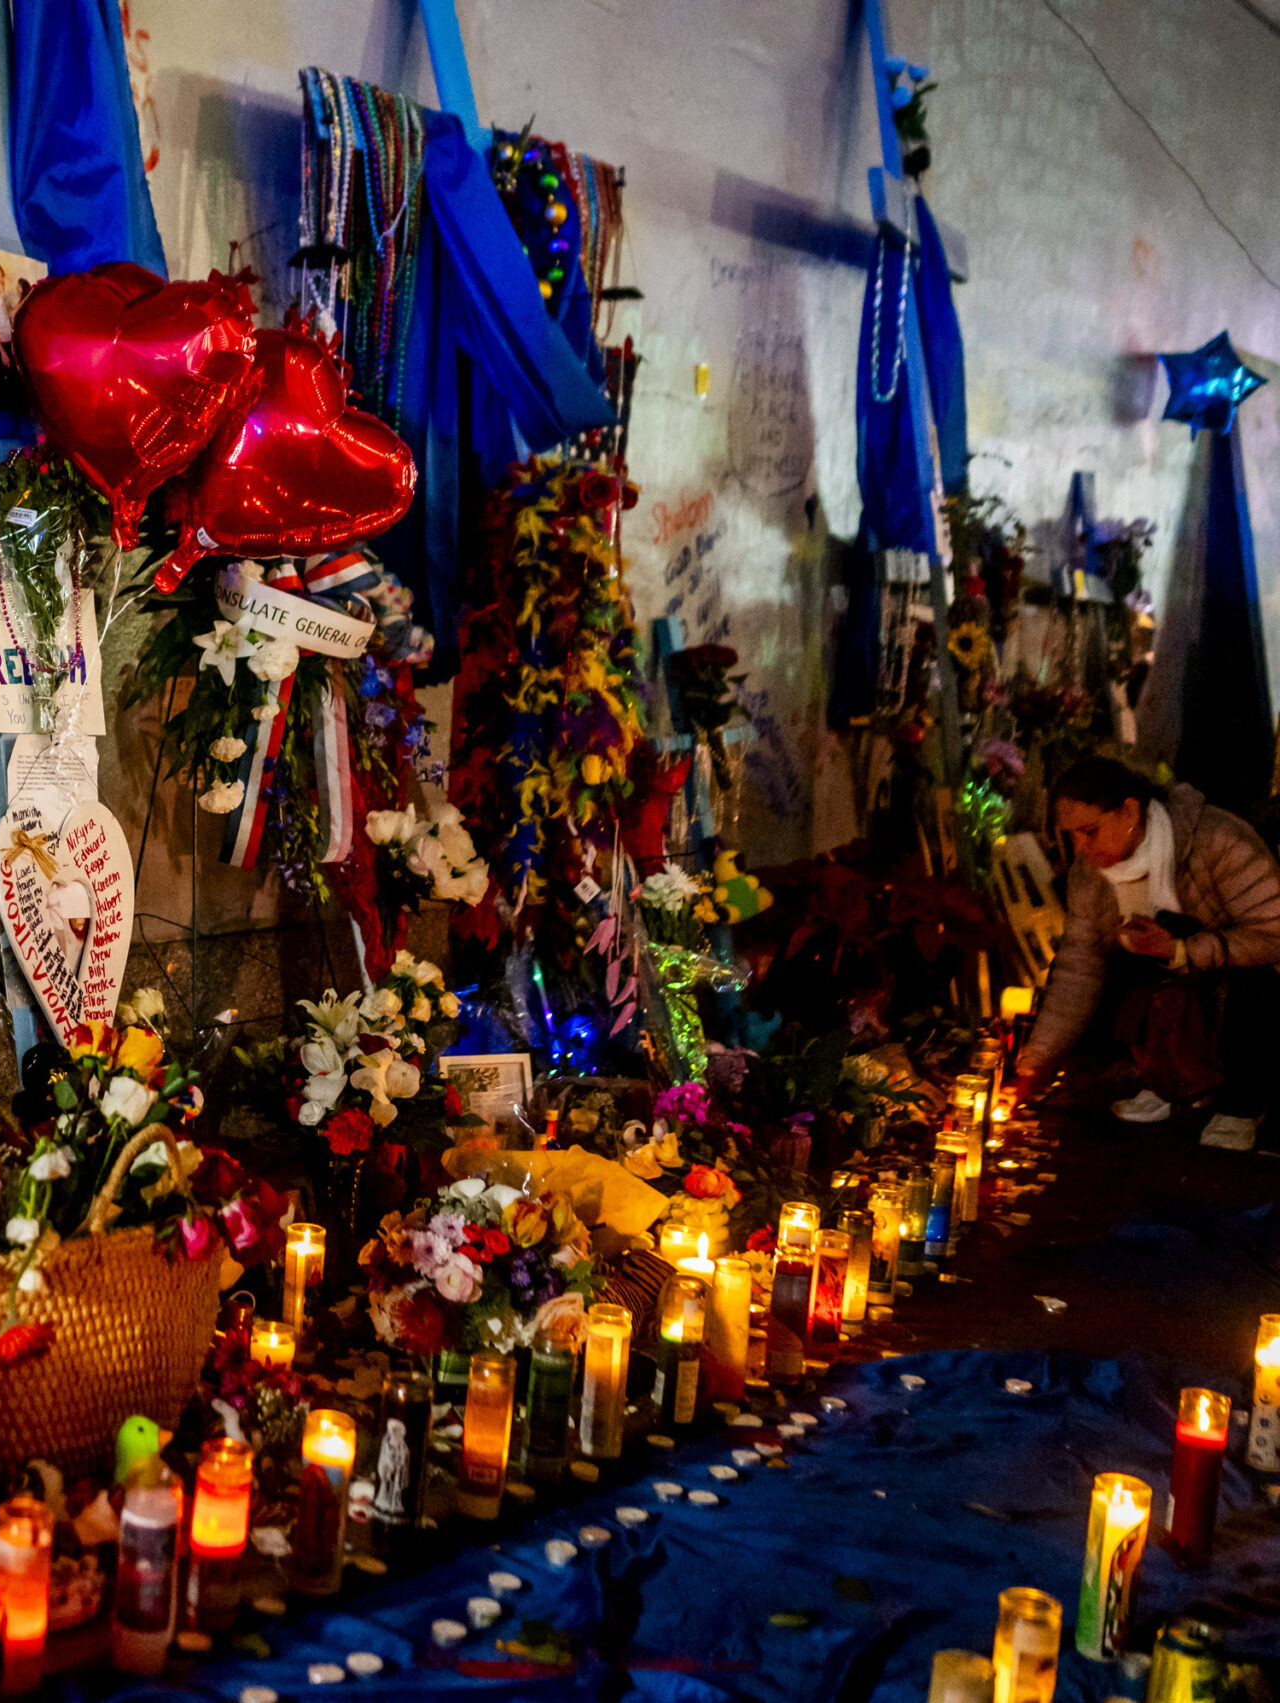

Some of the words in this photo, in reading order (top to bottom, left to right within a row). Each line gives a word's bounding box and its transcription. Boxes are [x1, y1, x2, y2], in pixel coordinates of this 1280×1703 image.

[295, 616, 353, 647] GENERAL
[73, 825, 106, 868] Edward
[91, 871, 121, 898] Kareem
[95, 889, 122, 917] Hubert
[95, 910, 123, 933] Nicole
[89, 947, 112, 965] Drew
